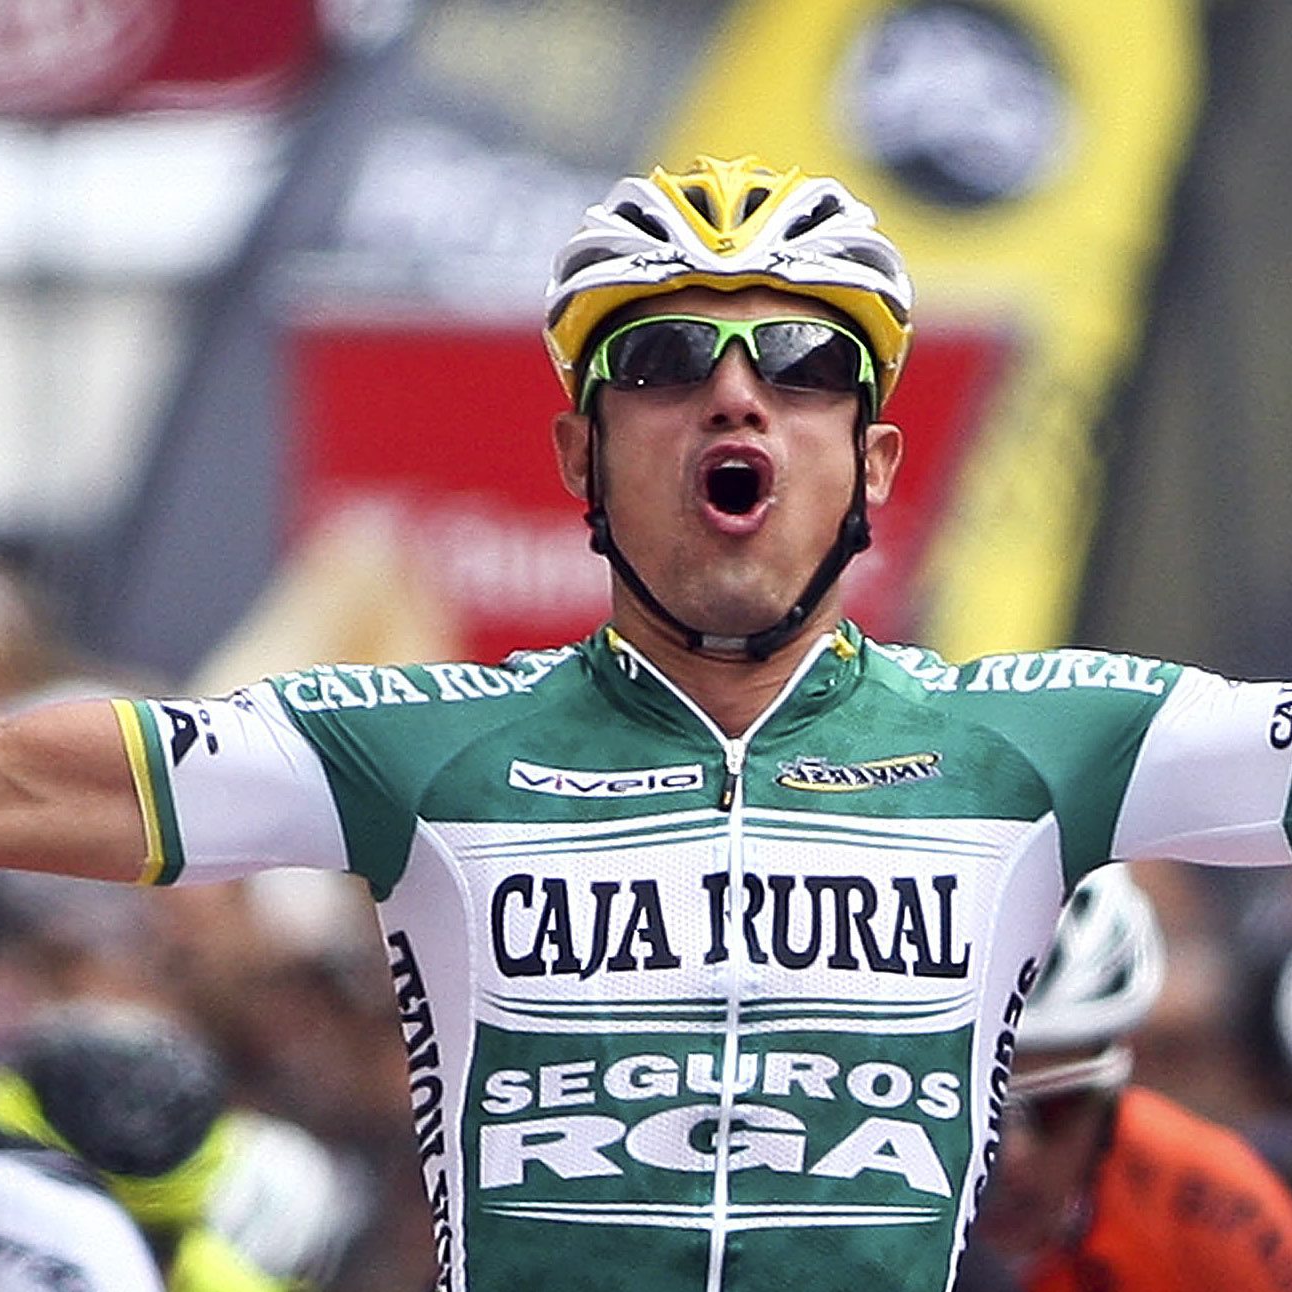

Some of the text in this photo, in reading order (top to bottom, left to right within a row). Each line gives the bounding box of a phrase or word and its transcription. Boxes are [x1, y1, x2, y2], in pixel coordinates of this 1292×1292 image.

[283, 668, 430, 712] CAJA
[966, 650, 1167, 696] RURAL
[490, 872, 972, 981] CAJA RURAL
[480, 1052, 962, 1120] SEGUROS
[479, 1104, 953, 1199] RGA
